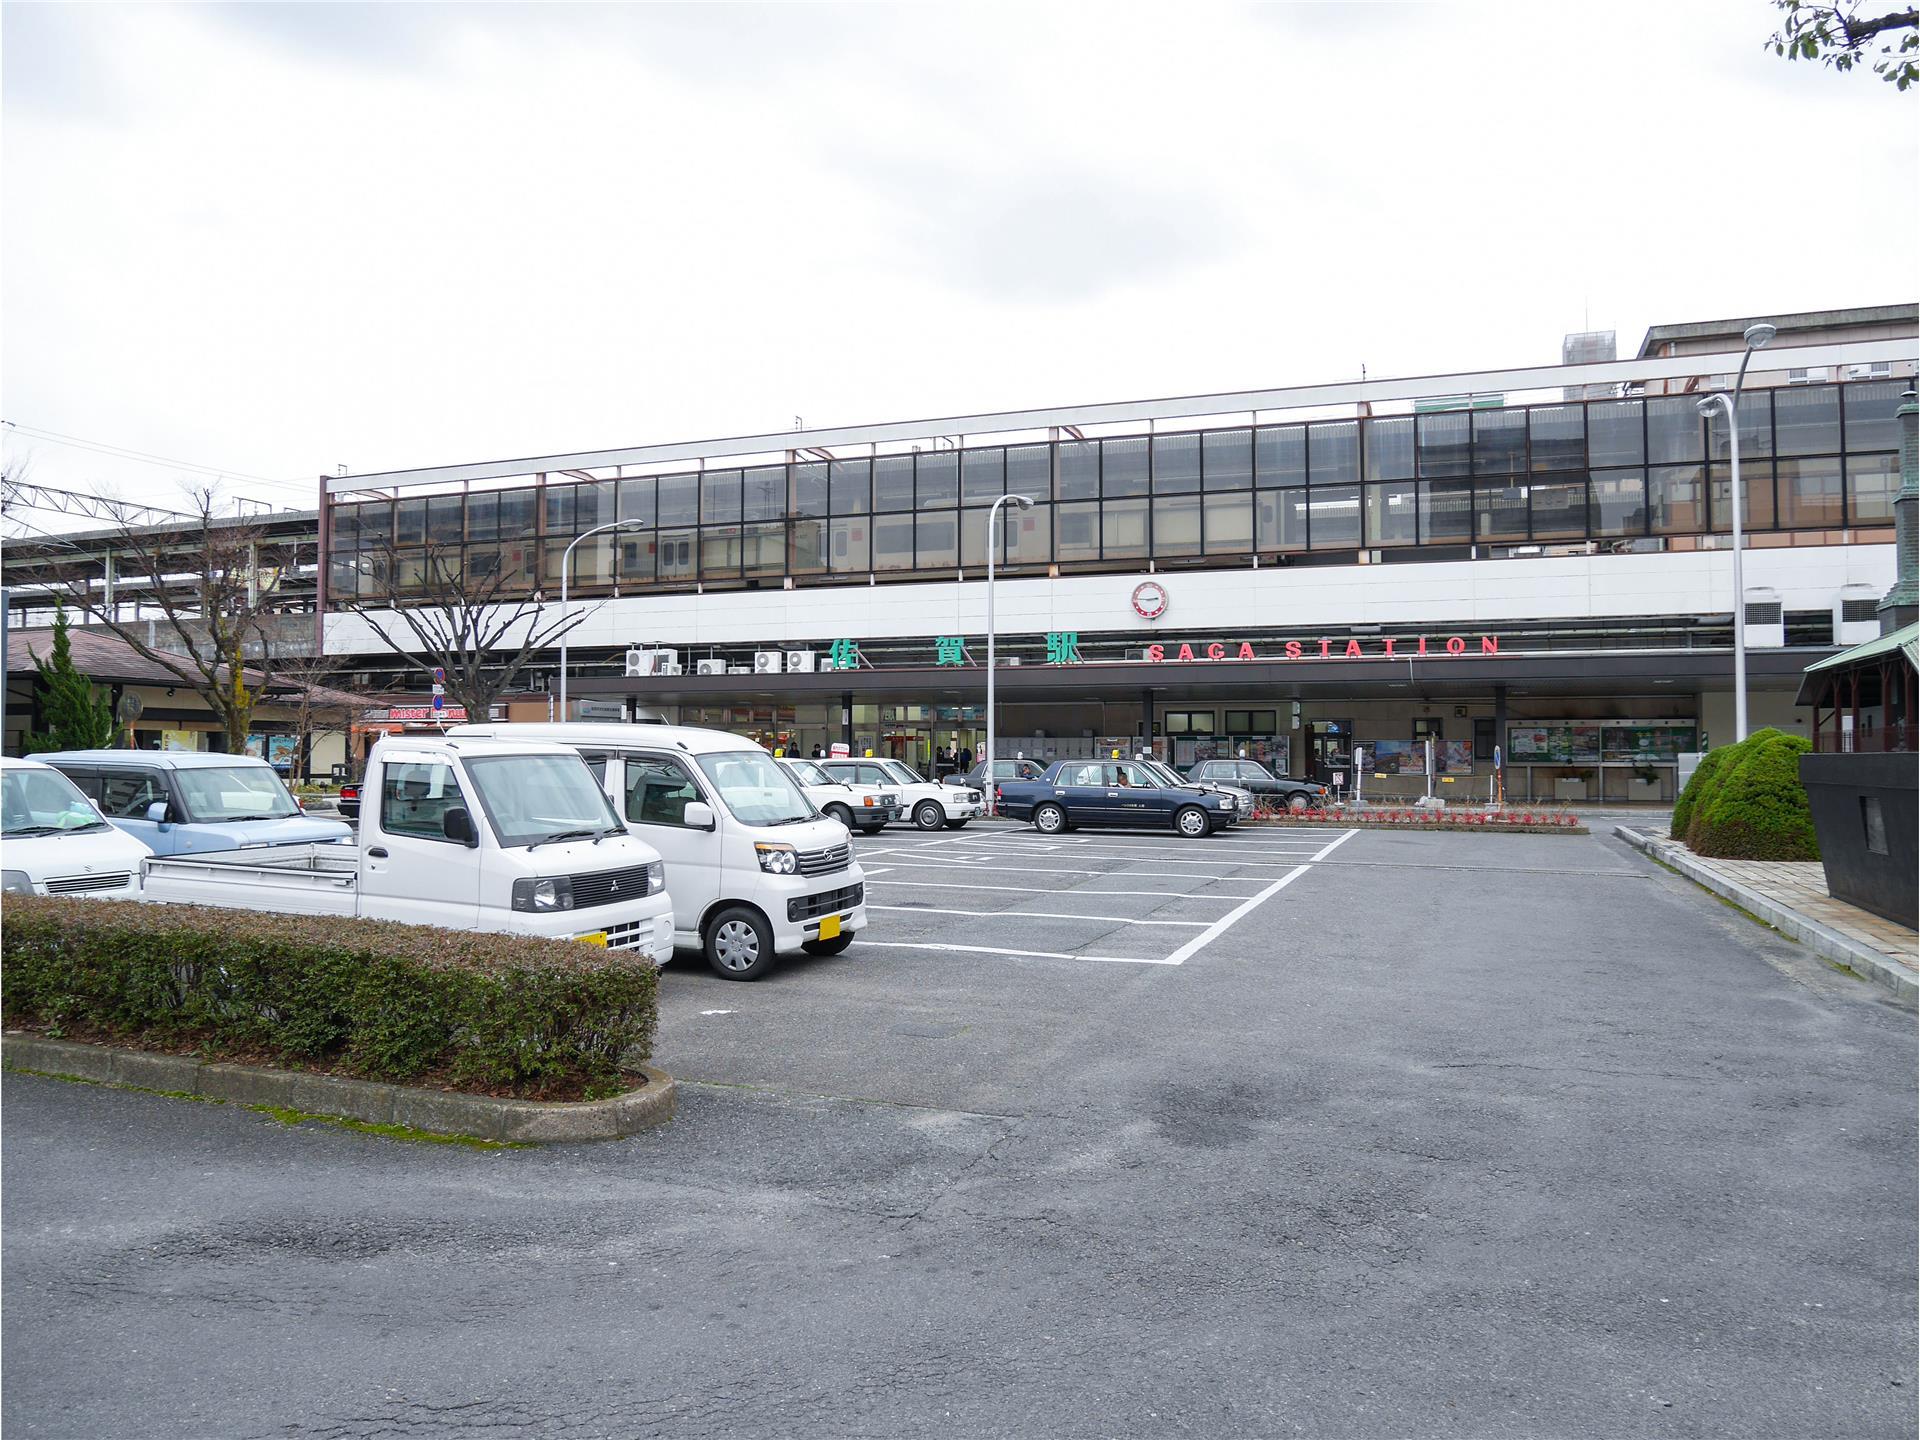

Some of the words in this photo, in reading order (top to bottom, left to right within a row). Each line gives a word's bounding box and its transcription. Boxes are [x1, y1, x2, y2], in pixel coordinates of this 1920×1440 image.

[829, 631, 1078, 669] 佐賀駅
[1148, 642, 1255, 660] SAGA
[1286, 635, 1499, 658] STATION
[389, 707, 430, 719] mister
[431, 707, 467, 719] nut
